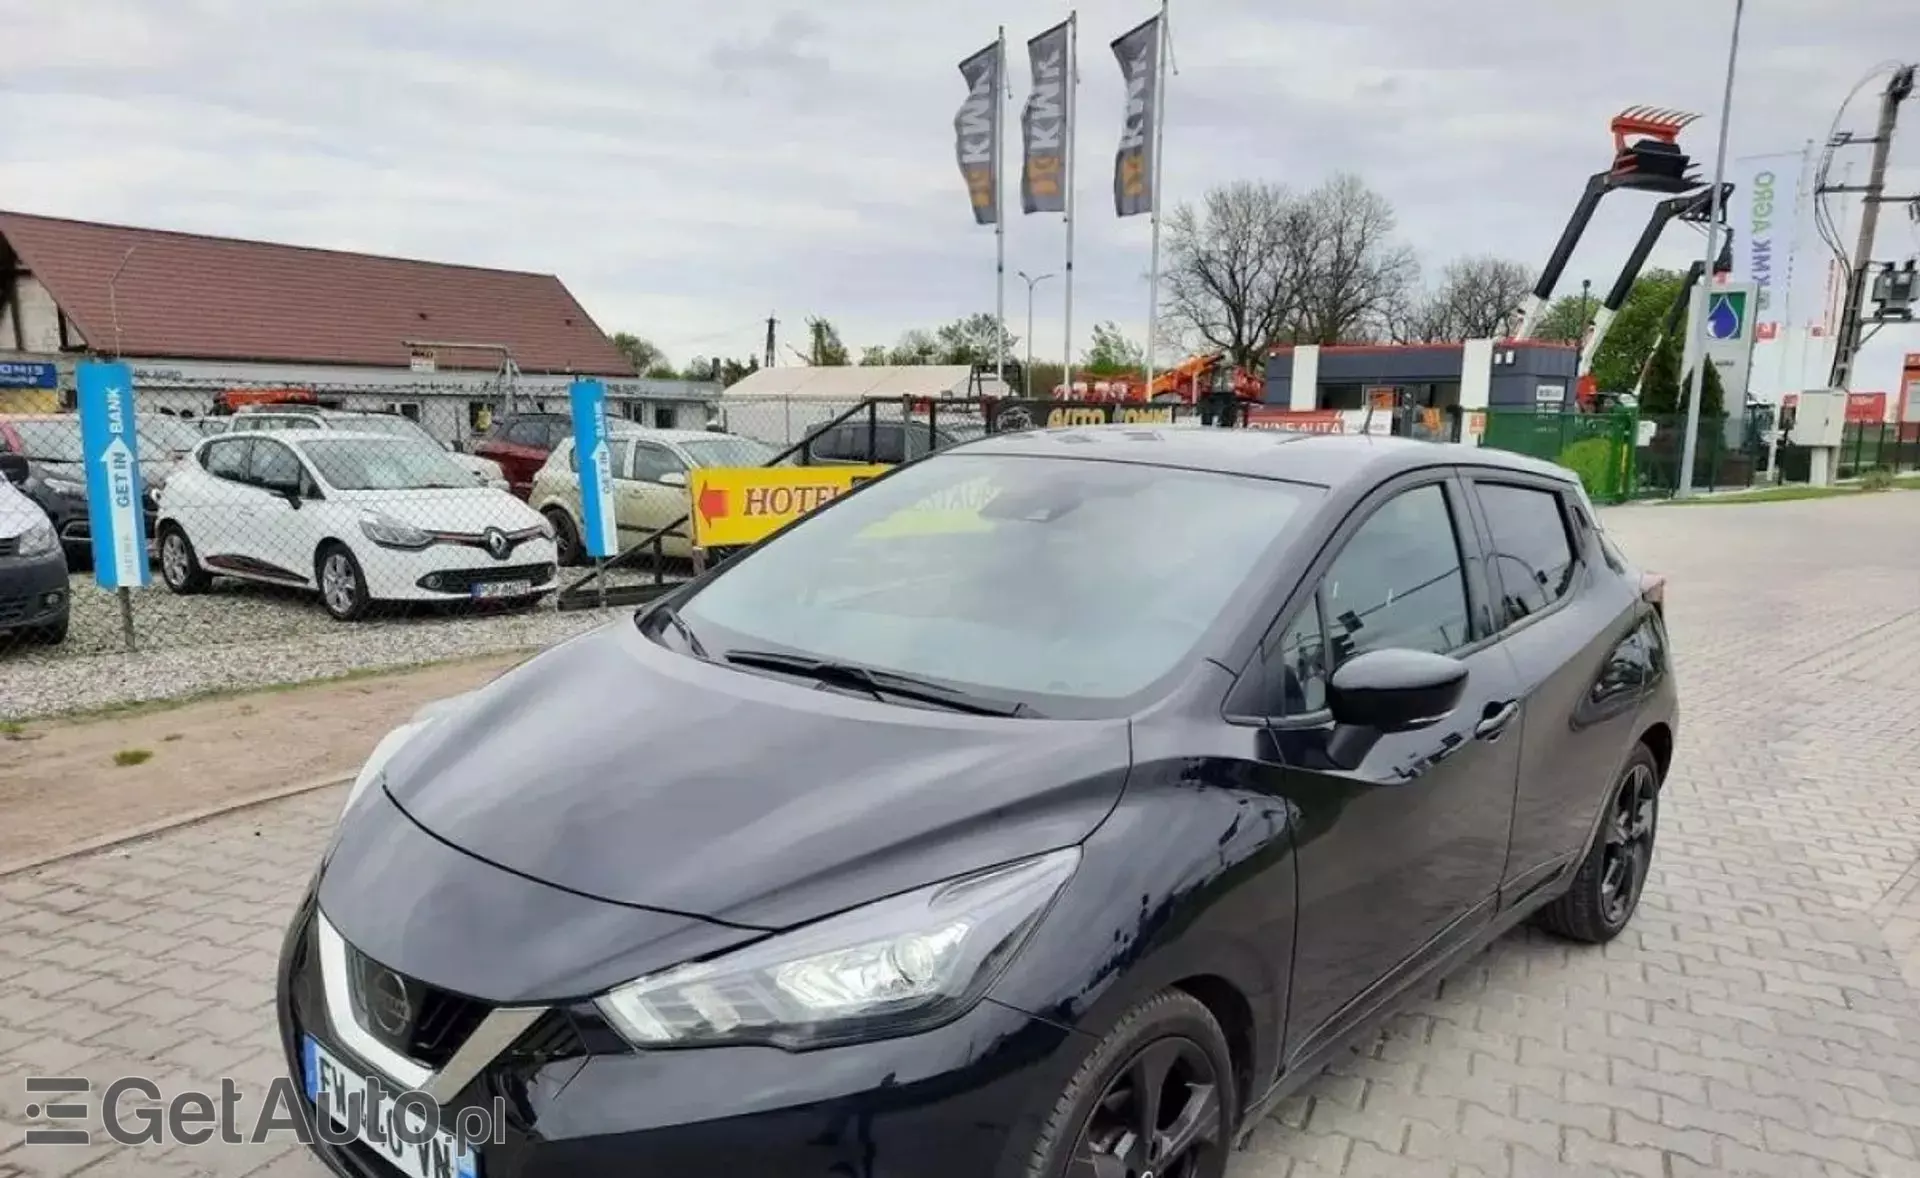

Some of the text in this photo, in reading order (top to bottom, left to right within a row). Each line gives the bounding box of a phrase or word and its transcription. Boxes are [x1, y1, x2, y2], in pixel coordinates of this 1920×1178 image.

[107, 387, 131, 508] GET IN BANK
